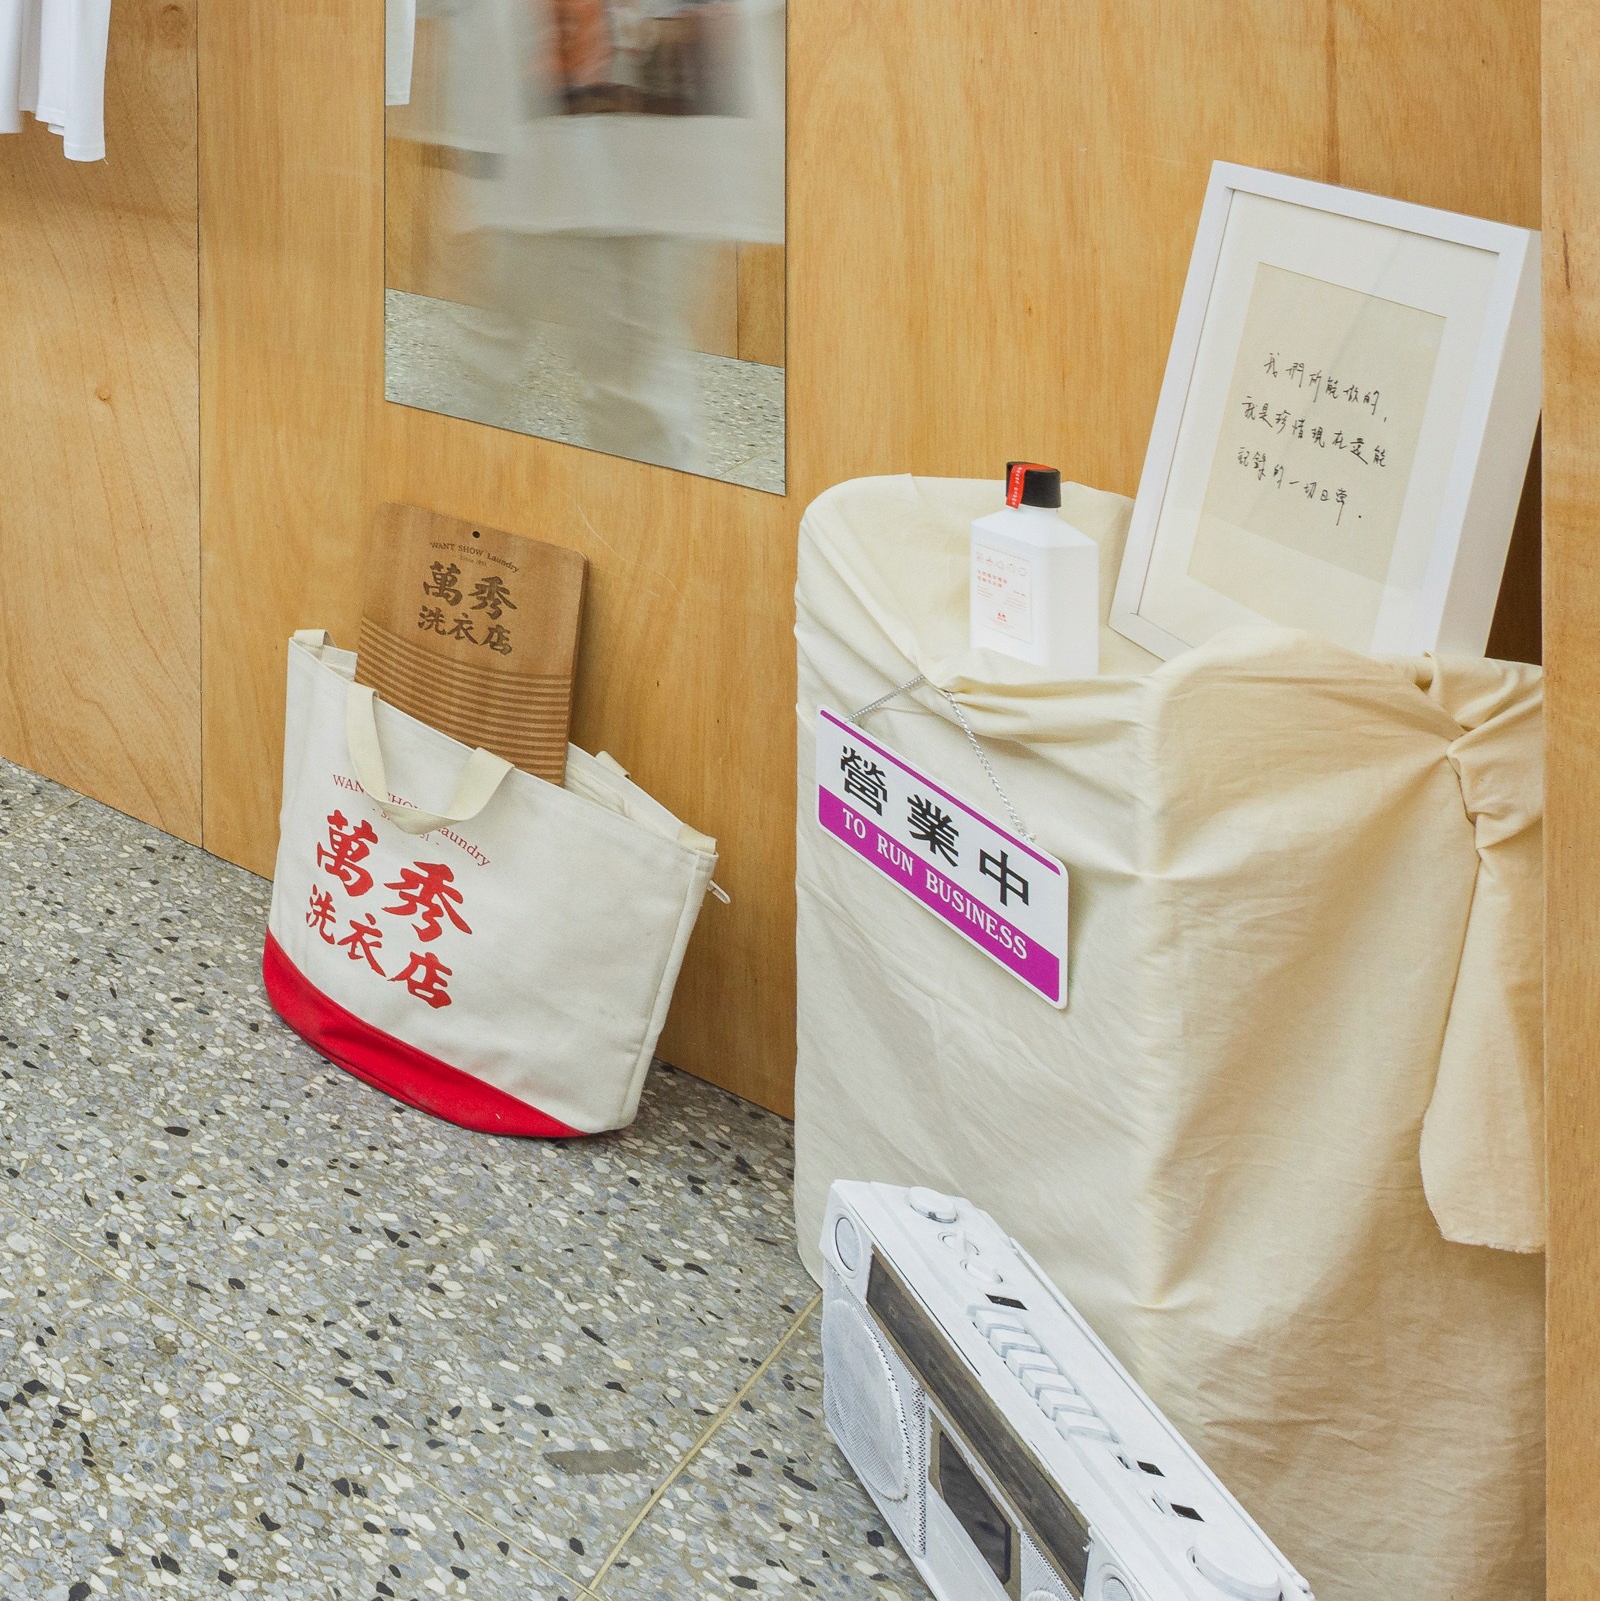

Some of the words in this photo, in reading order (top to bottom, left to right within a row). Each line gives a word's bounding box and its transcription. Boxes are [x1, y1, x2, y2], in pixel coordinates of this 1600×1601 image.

[422, 560, 518, 621] 萬秀
[430, 541, 456, 551] WANT
[458, 544, 484, 557] SHOW
[487, 552, 520, 574] Laundry
[417, 605, 513, 656] 洗衣店
[332, 774, 366, 795] WAN
[436, 826, 491, 867] aundry
[840, 744, 1030, 907] 營業中
[315, 809, 473, 945] 萬秀
[842, 807, 867, 840] TO
[876, 836, 914, 877] RUN
[925, 869, 1028, 961] BUSINESS
[305, 884, 453, 1010] 洗衣店
